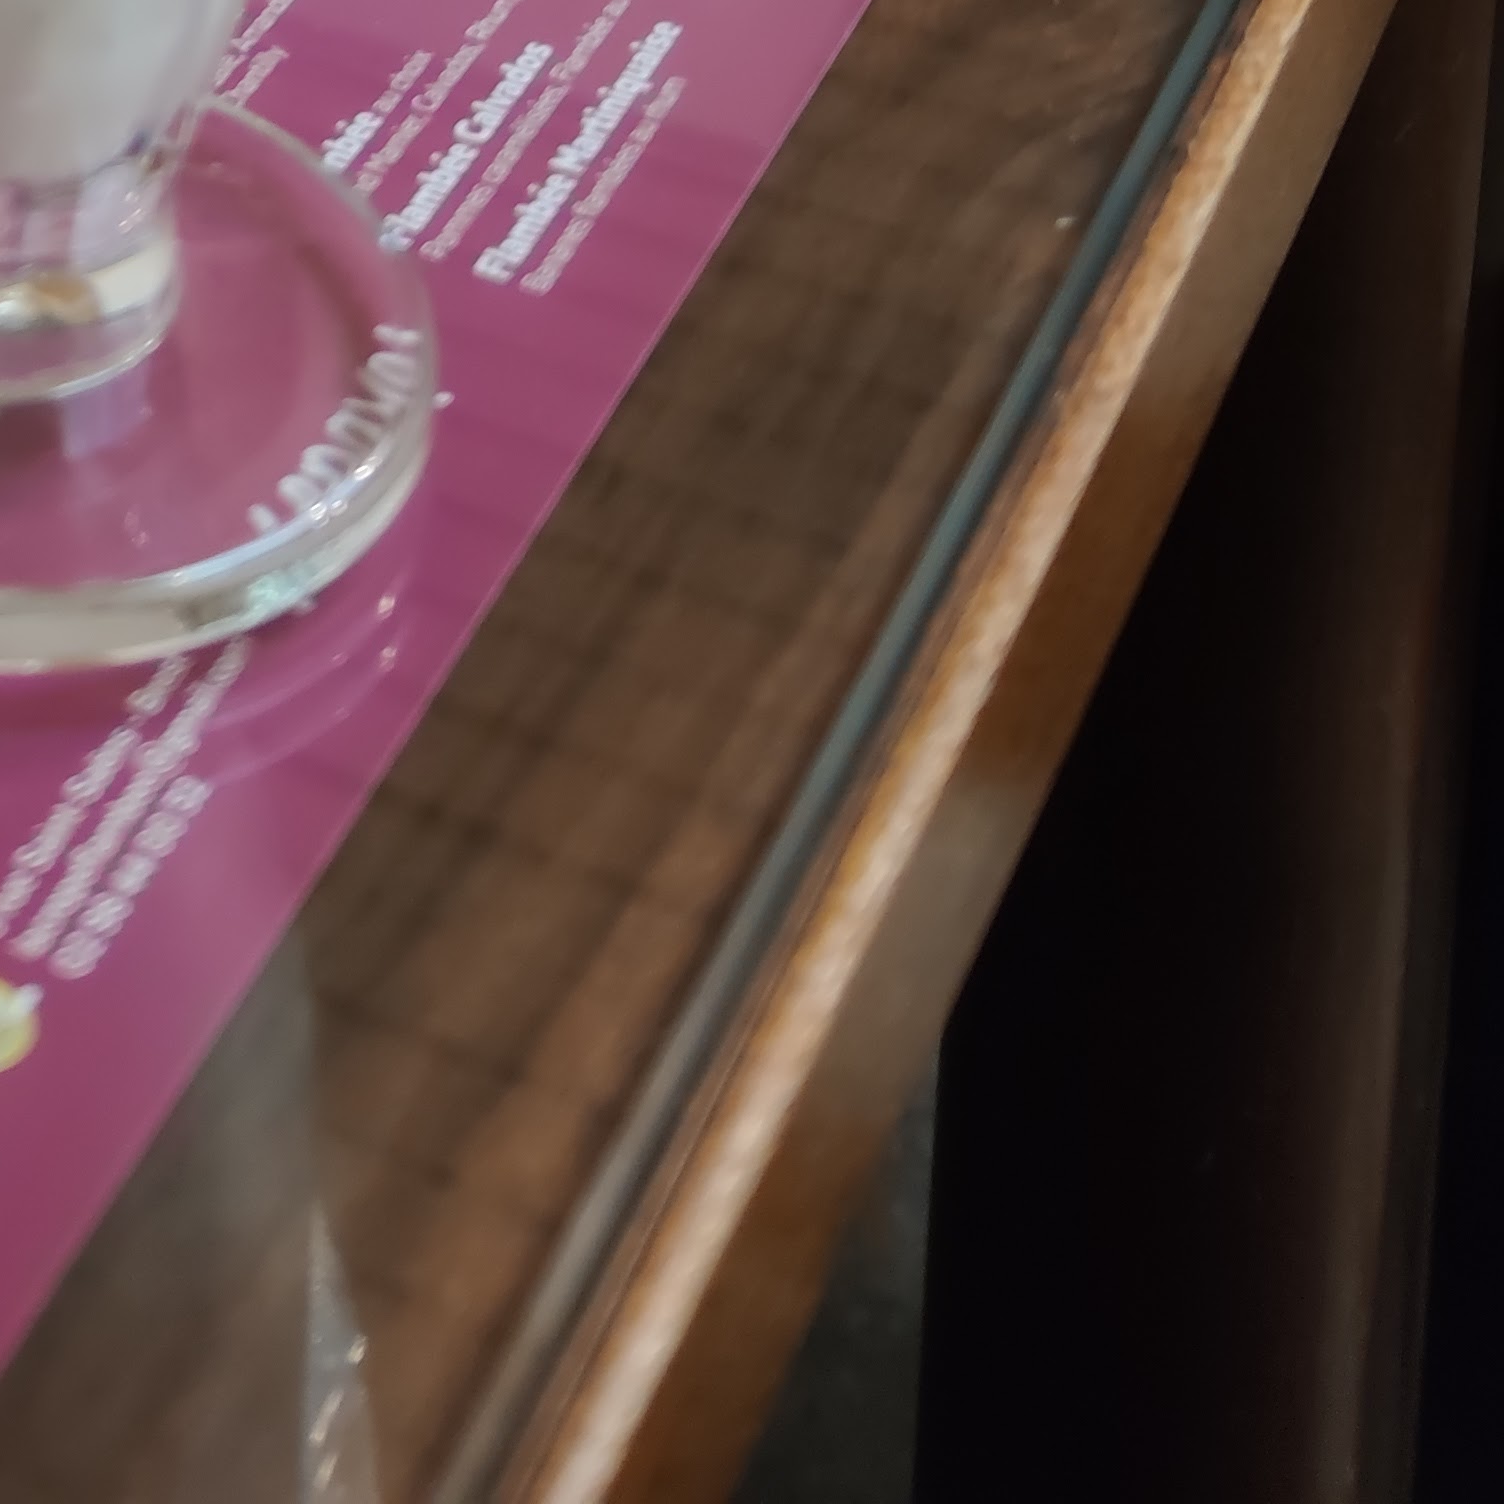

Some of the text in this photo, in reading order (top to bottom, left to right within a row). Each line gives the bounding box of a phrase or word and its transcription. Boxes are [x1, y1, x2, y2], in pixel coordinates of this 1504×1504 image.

[453, 40, 555, 145] Calvados
[472, 172, 580, 285] Flambée
[547, 20, 684, 178] Martiniquaise
